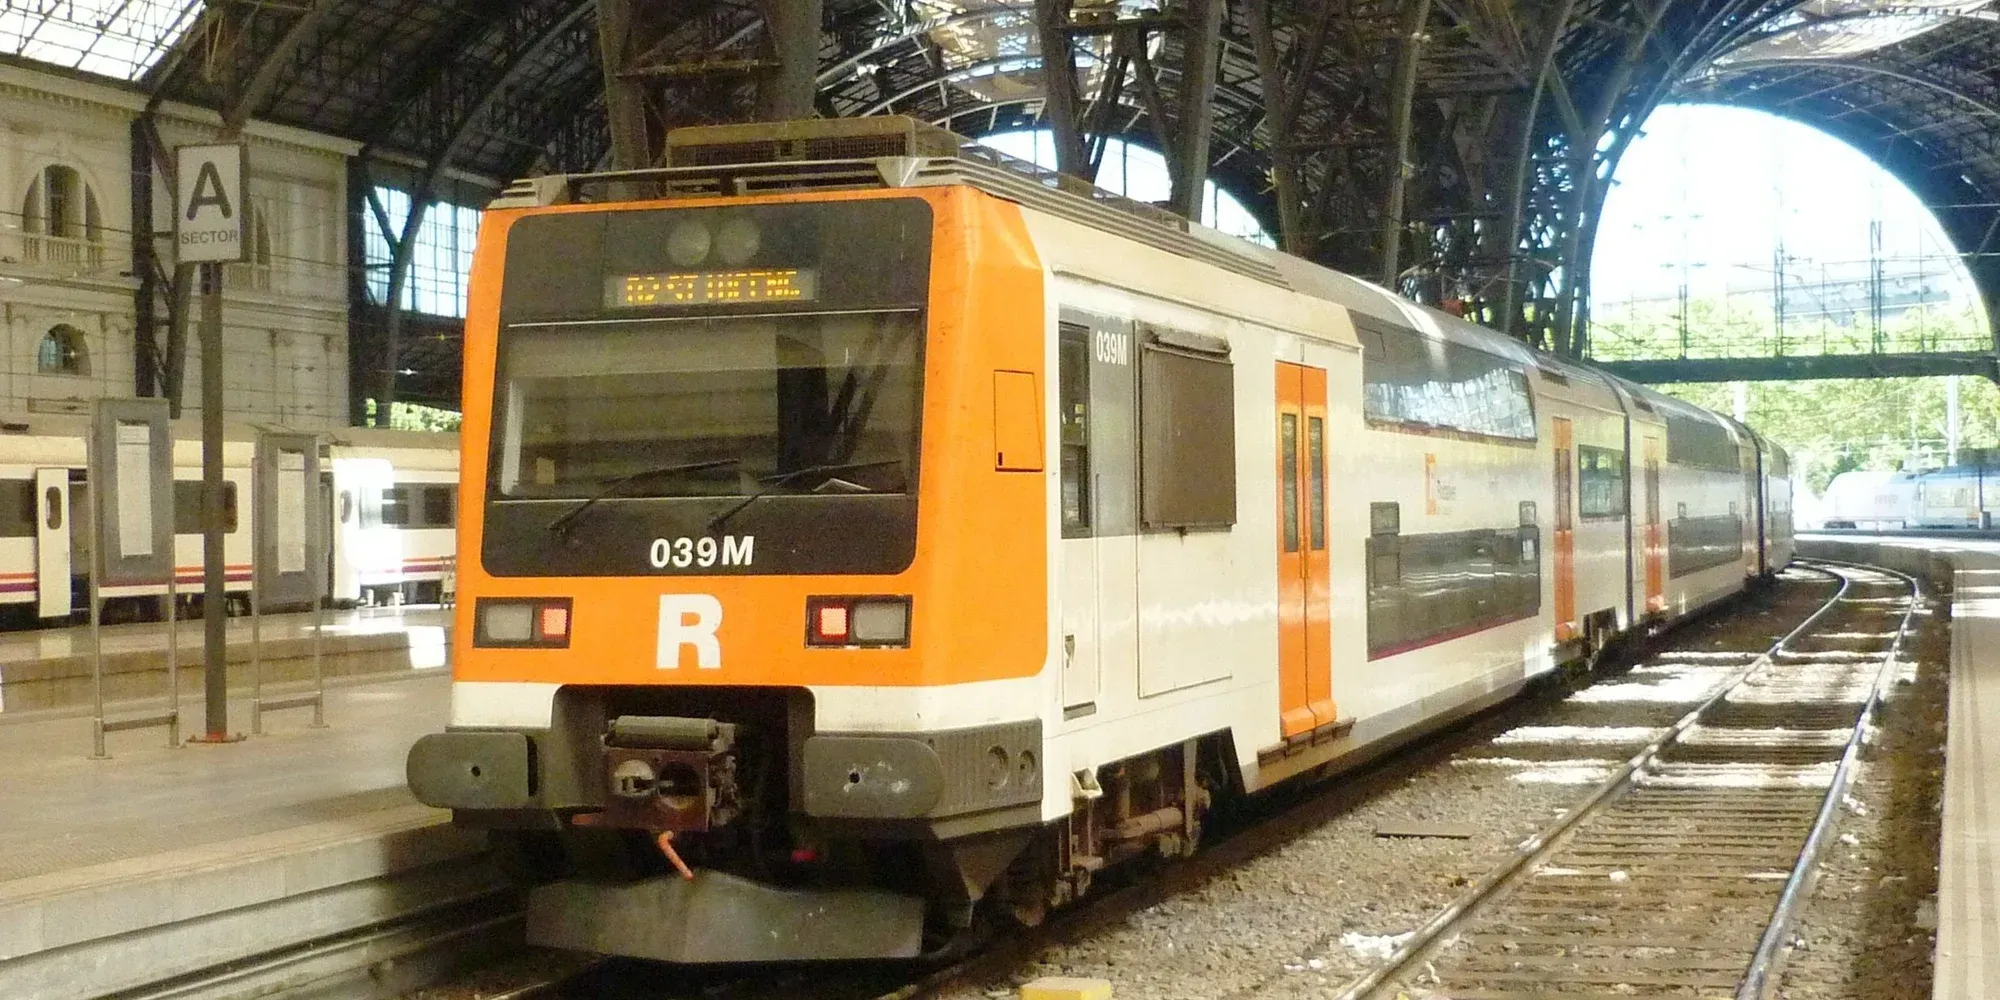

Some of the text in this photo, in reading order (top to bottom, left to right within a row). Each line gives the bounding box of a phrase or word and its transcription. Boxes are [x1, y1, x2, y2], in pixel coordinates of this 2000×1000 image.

[186, 161, 233, 221] A
[180, 229, 239, 245] SECTOR
[1096, 330, 1127, 366] 039M
[650, 535, 755, 568] 039M
[656, 593, 723, 670] R
